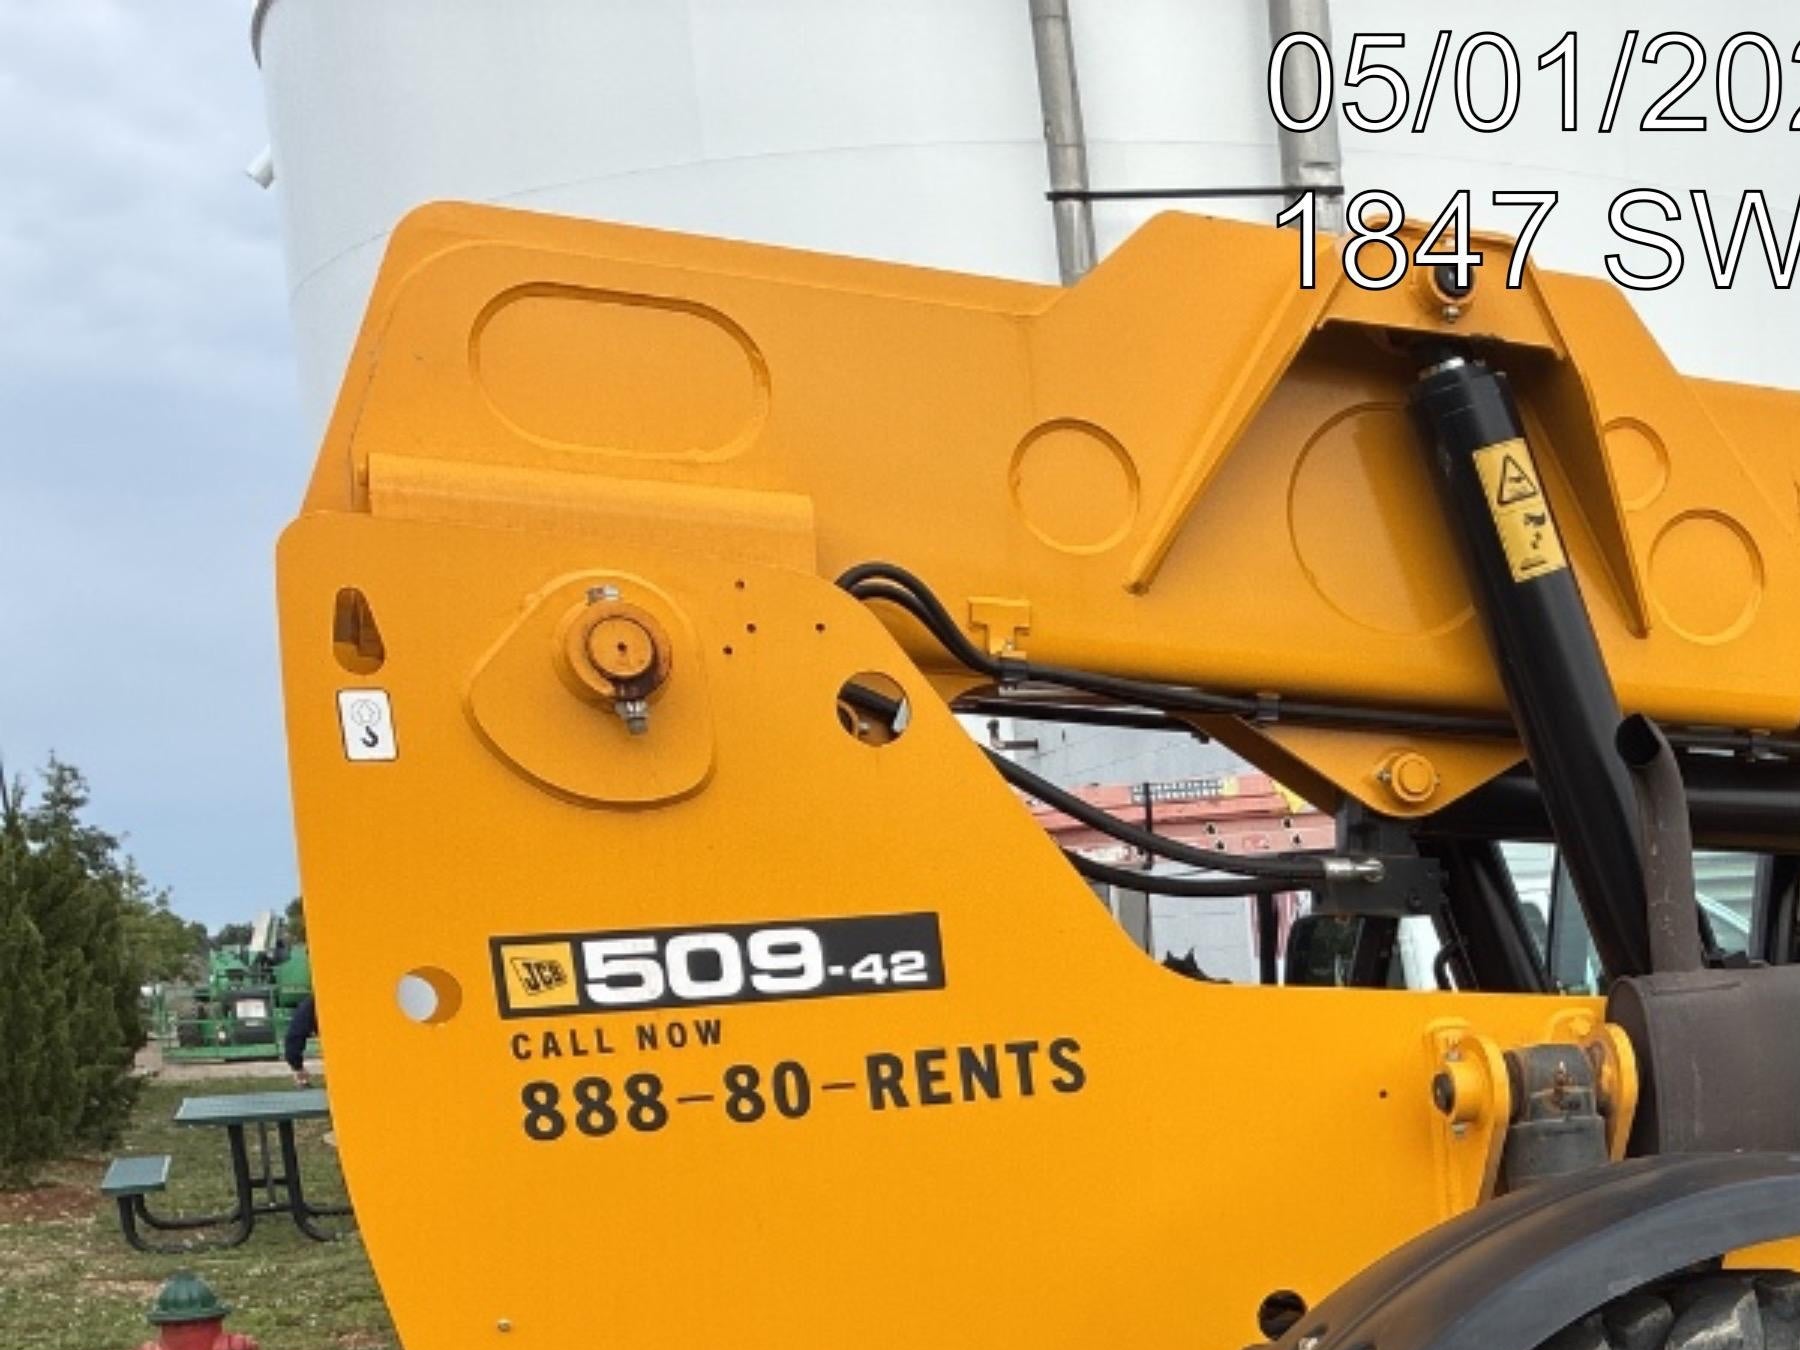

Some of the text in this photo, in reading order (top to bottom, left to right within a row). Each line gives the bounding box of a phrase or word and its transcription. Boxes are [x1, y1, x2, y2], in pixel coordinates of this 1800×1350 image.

[581, 926, 930, 1006] 509-42
[510, 1018, 723, 1061] CALL NOW
[520, 1036, 1087, 1142] 888-80-RENTS
